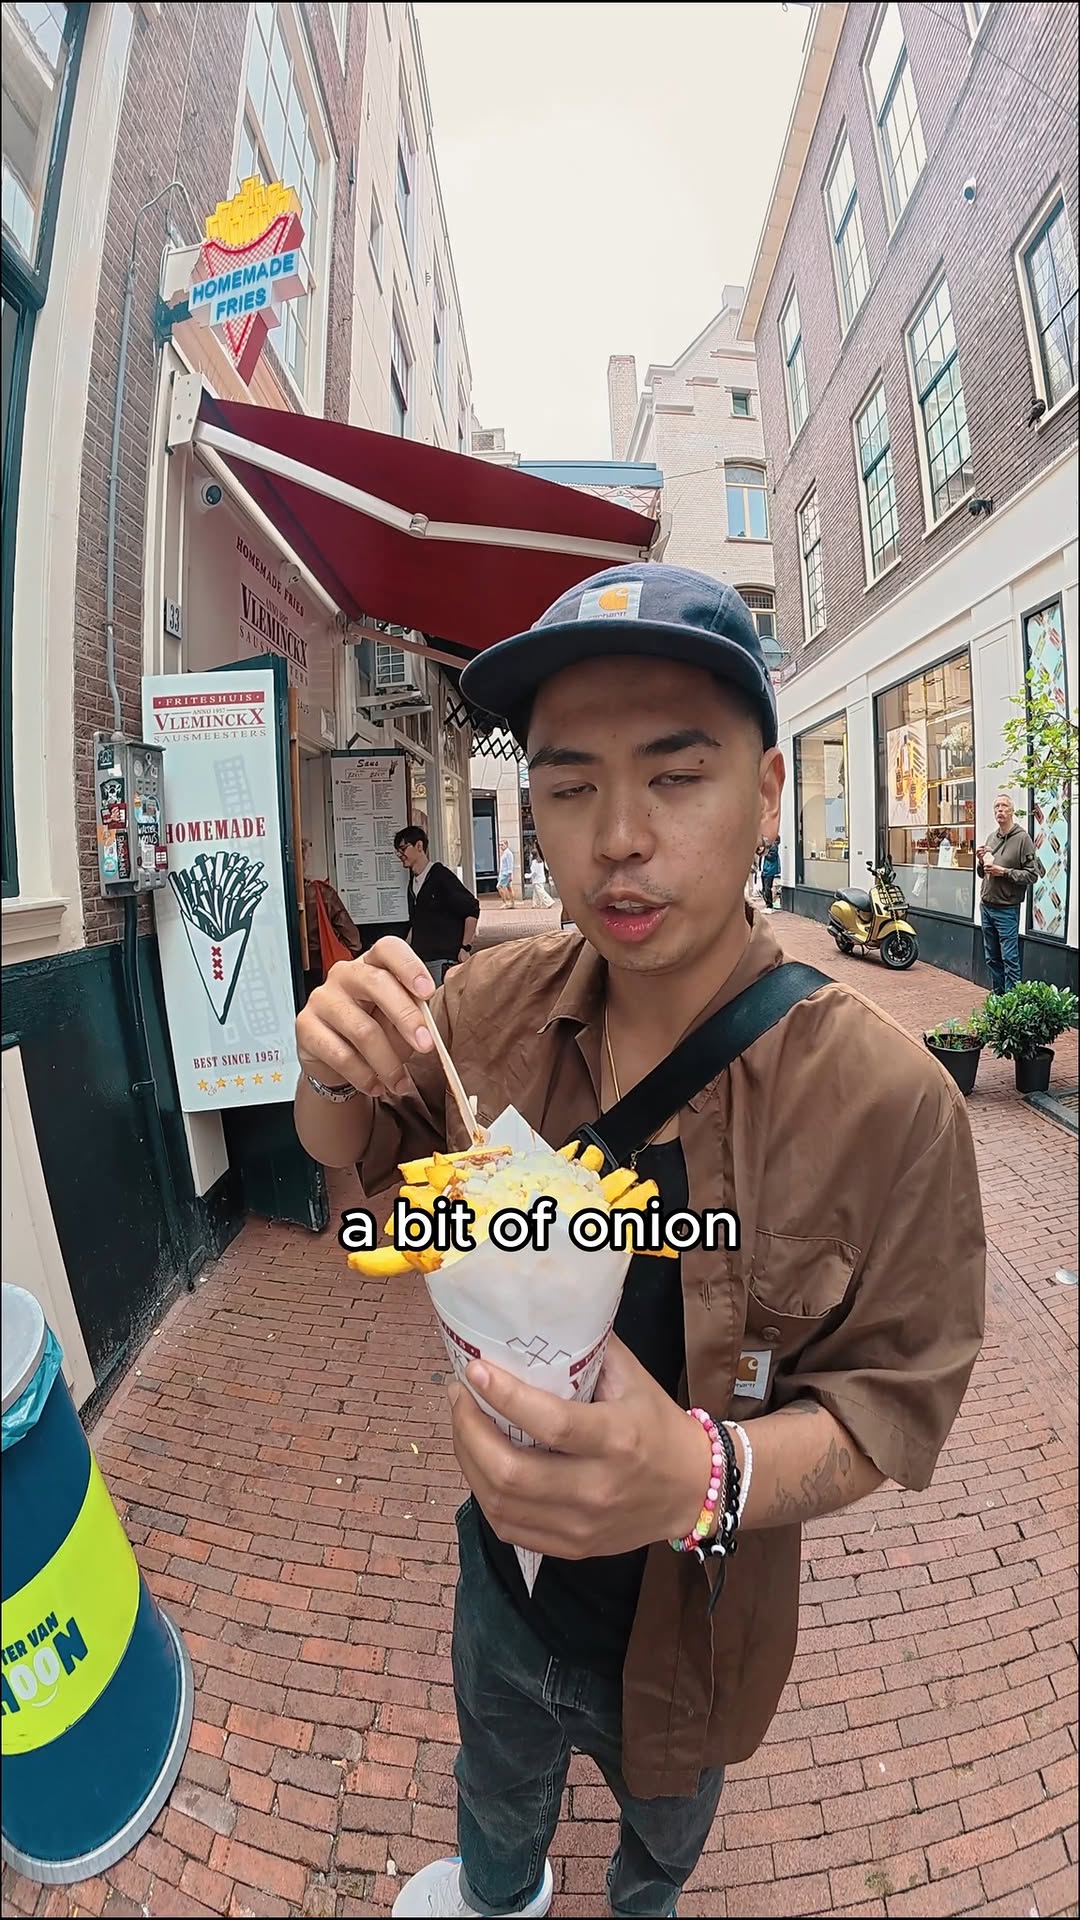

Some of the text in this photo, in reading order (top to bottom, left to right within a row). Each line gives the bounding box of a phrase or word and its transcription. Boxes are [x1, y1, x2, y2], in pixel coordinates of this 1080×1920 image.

[192, 253, 295, 304] HOMEMADE
[216, 288, 266, 320] FRIES
[236, 536, 304, 617] HOMEMADE FRIES
[170, 604, 180, 632] 33
[241, 583, 308, 669] VLEMINCKX
[166, 694, 252, 706] FRITESHUIS
[153, 708, 266, 731] VLEMINCKX
[153, 730, 266, 744] SAUSMEESTERS
[165, 817, 266, 844] HOMEMADE
[194, 1050, 279, 1069] BEST SINCE 1957
[27, 1611, 59, 1648] VAN
